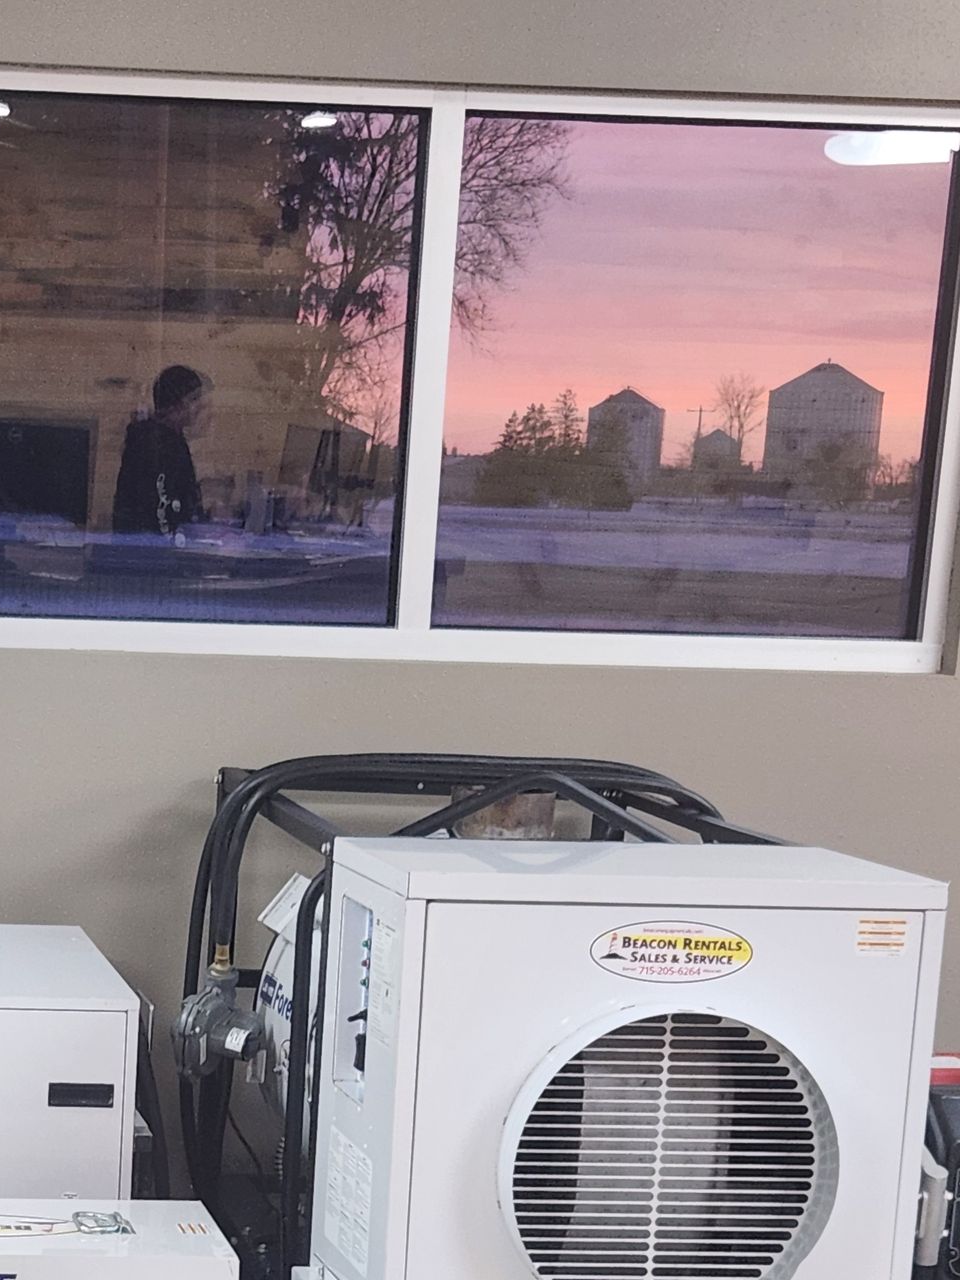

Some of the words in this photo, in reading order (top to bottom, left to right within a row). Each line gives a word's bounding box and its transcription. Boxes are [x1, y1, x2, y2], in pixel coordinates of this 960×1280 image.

[622, 936, 678, 950] BEACON
[683, 938, 742, 951] RENTALS
[630, 951, 667, 964] SALES
[670, 954, 680, 964] &
[684, 952, 733, 965] SERVICE
[639, 966, 701, 976] 715-205-6264
